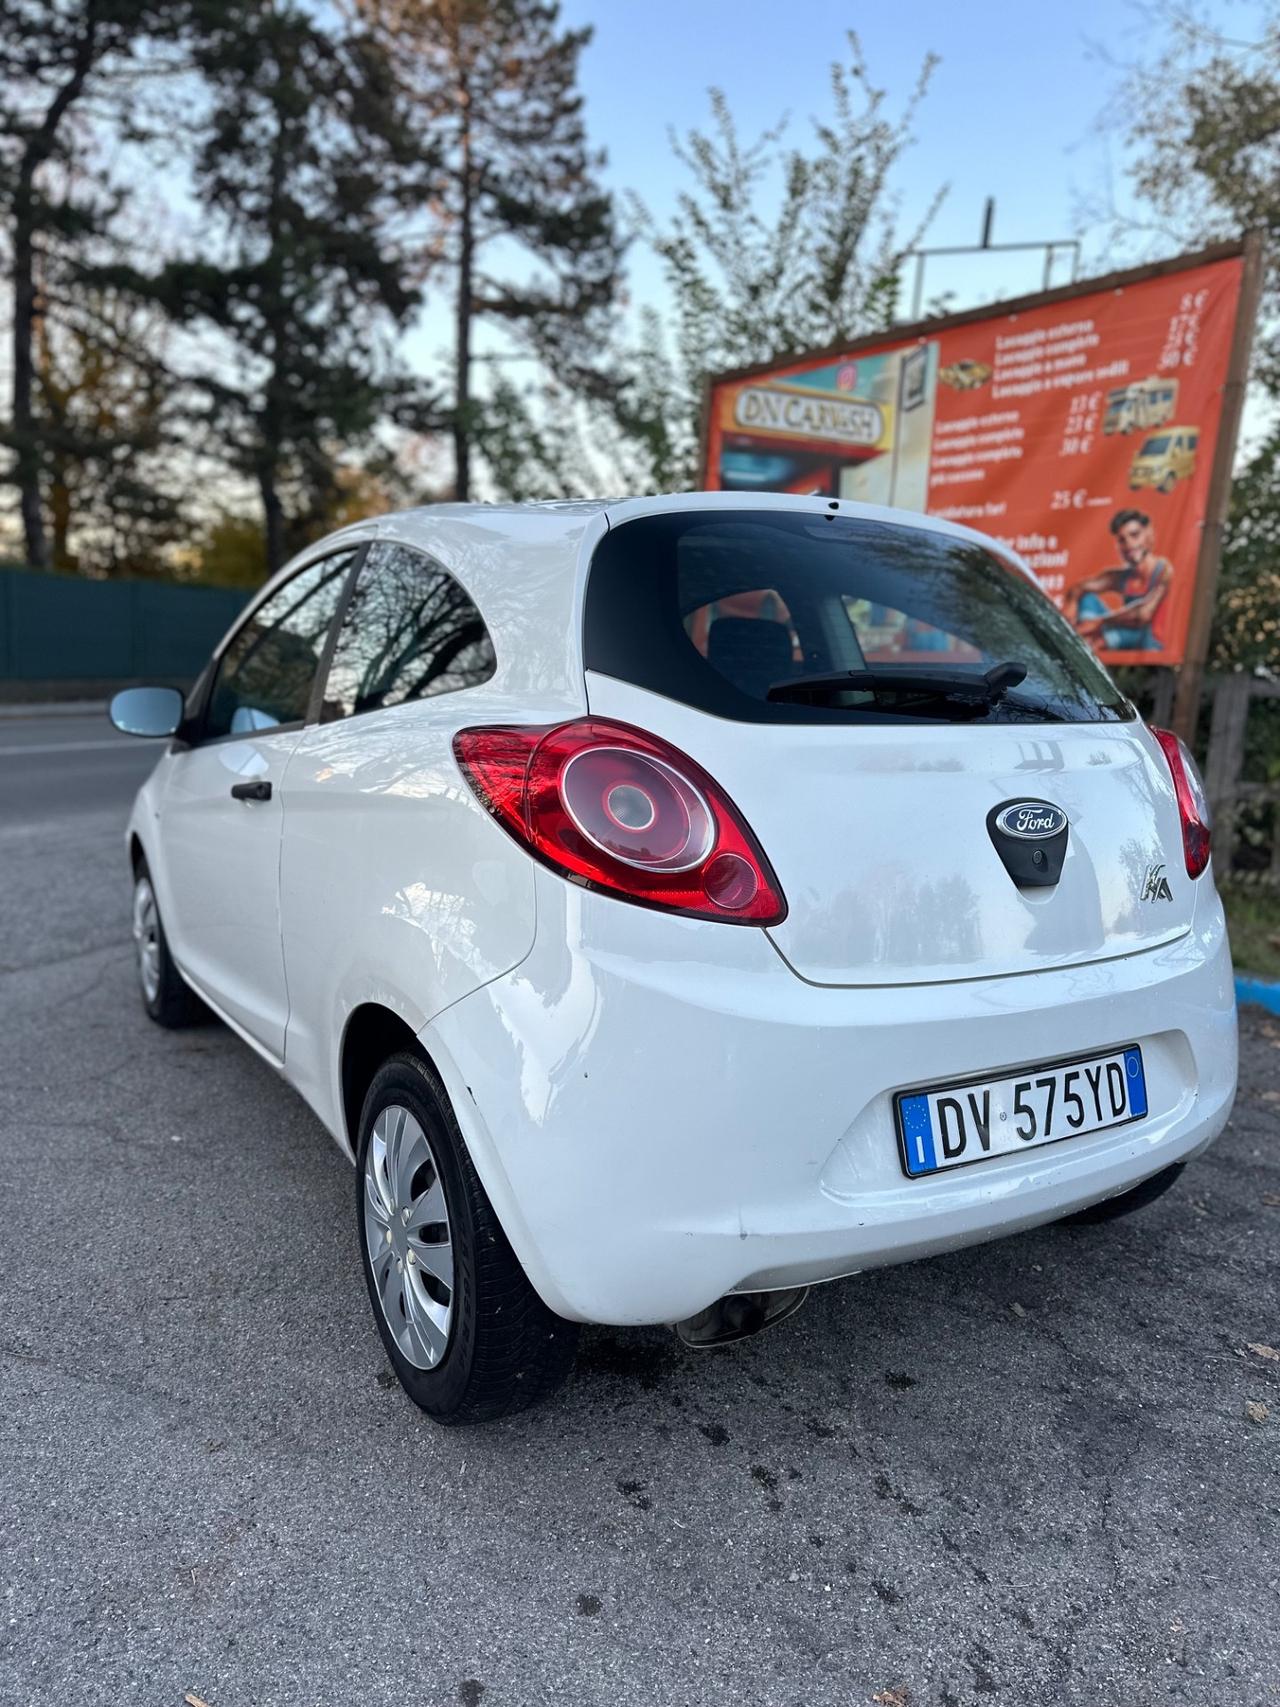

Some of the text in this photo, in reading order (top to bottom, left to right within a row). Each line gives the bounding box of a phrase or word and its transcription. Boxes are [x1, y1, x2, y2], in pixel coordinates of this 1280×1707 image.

[1016, 808, 1055, 831] Ford
[915, 1062, 1126, 1163] I DV 575YD
